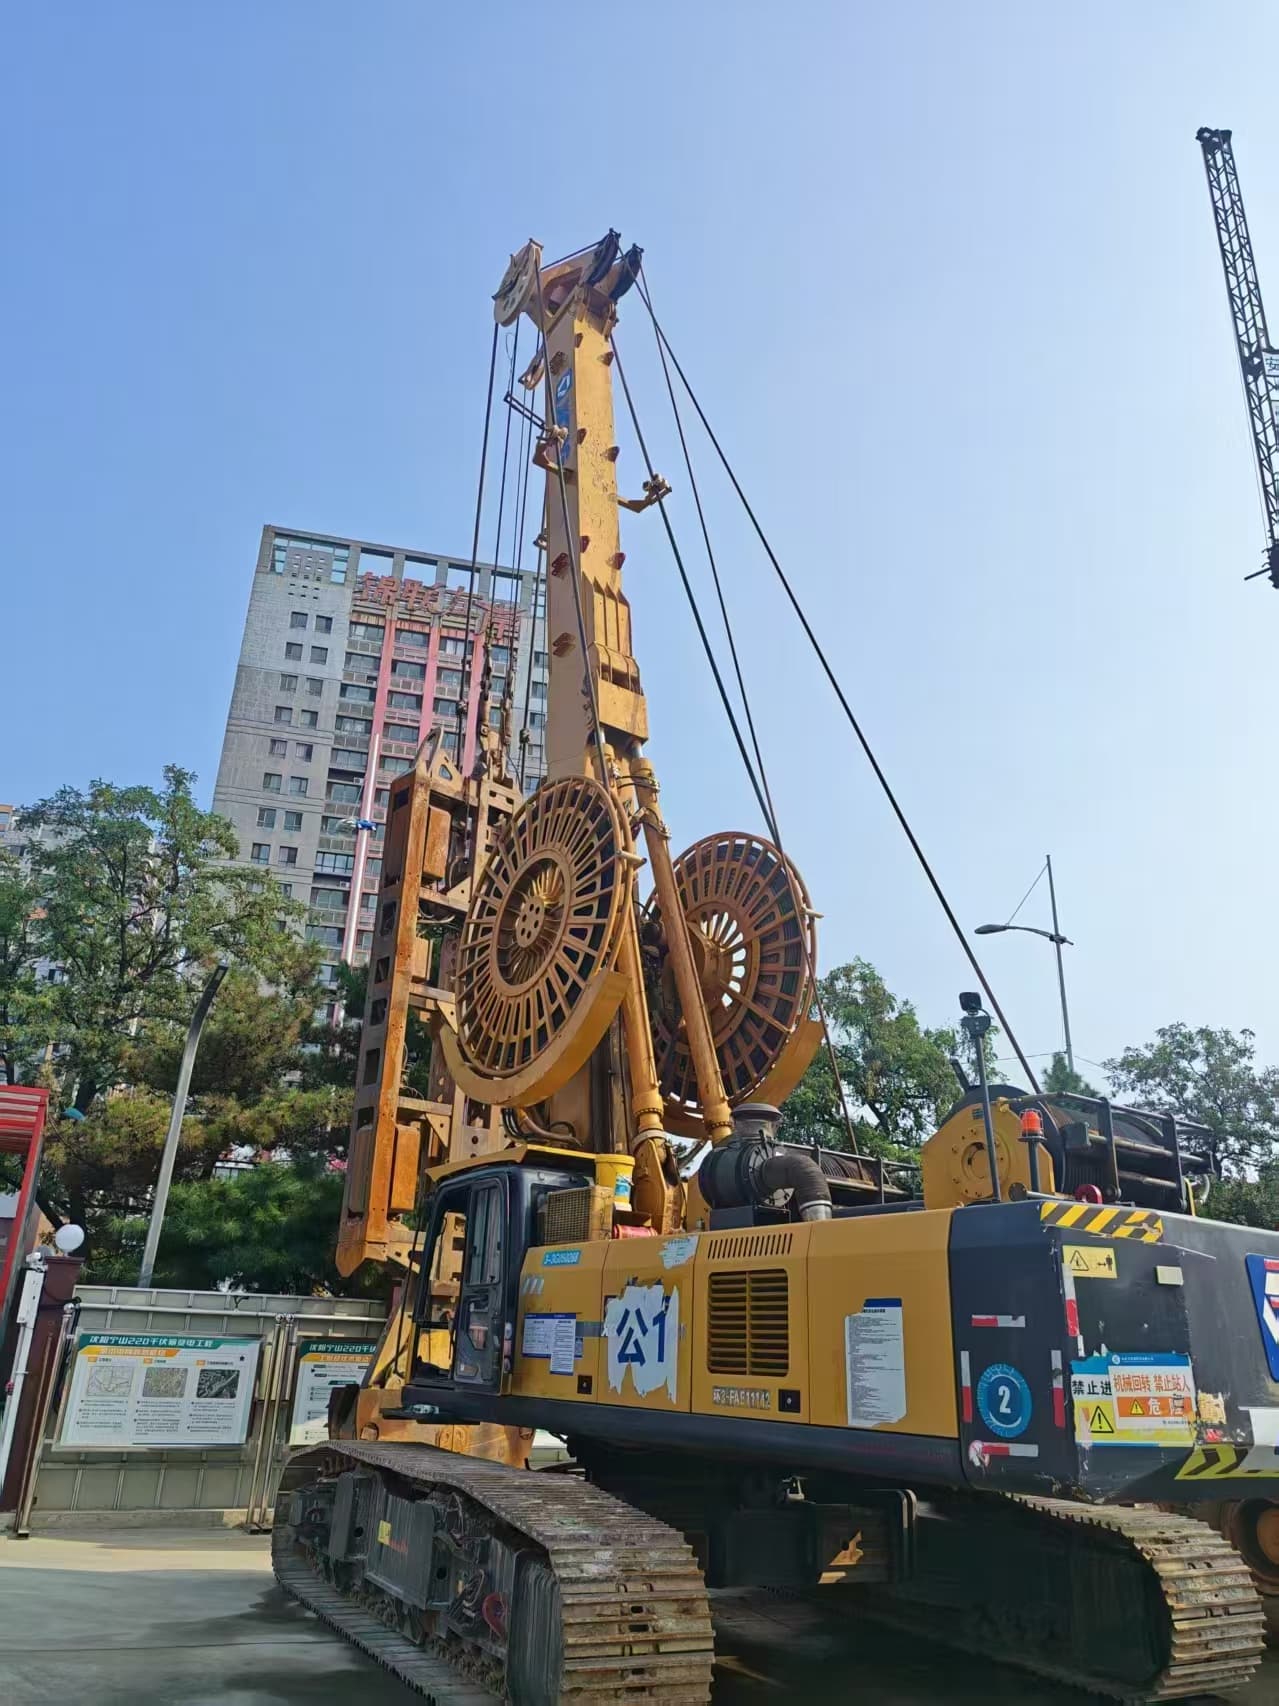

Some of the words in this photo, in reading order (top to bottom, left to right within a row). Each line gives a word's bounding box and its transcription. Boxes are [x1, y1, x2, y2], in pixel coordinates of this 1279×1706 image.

[89, 1335, 214, 1348] 沈阳宁山220千伏输变电工程
[1113, 1374, 1151, 1392] 机械回转
[1153, 1375, 1191, 1393] 禁止站人
[998, 1385, 1011, 1414] 2
